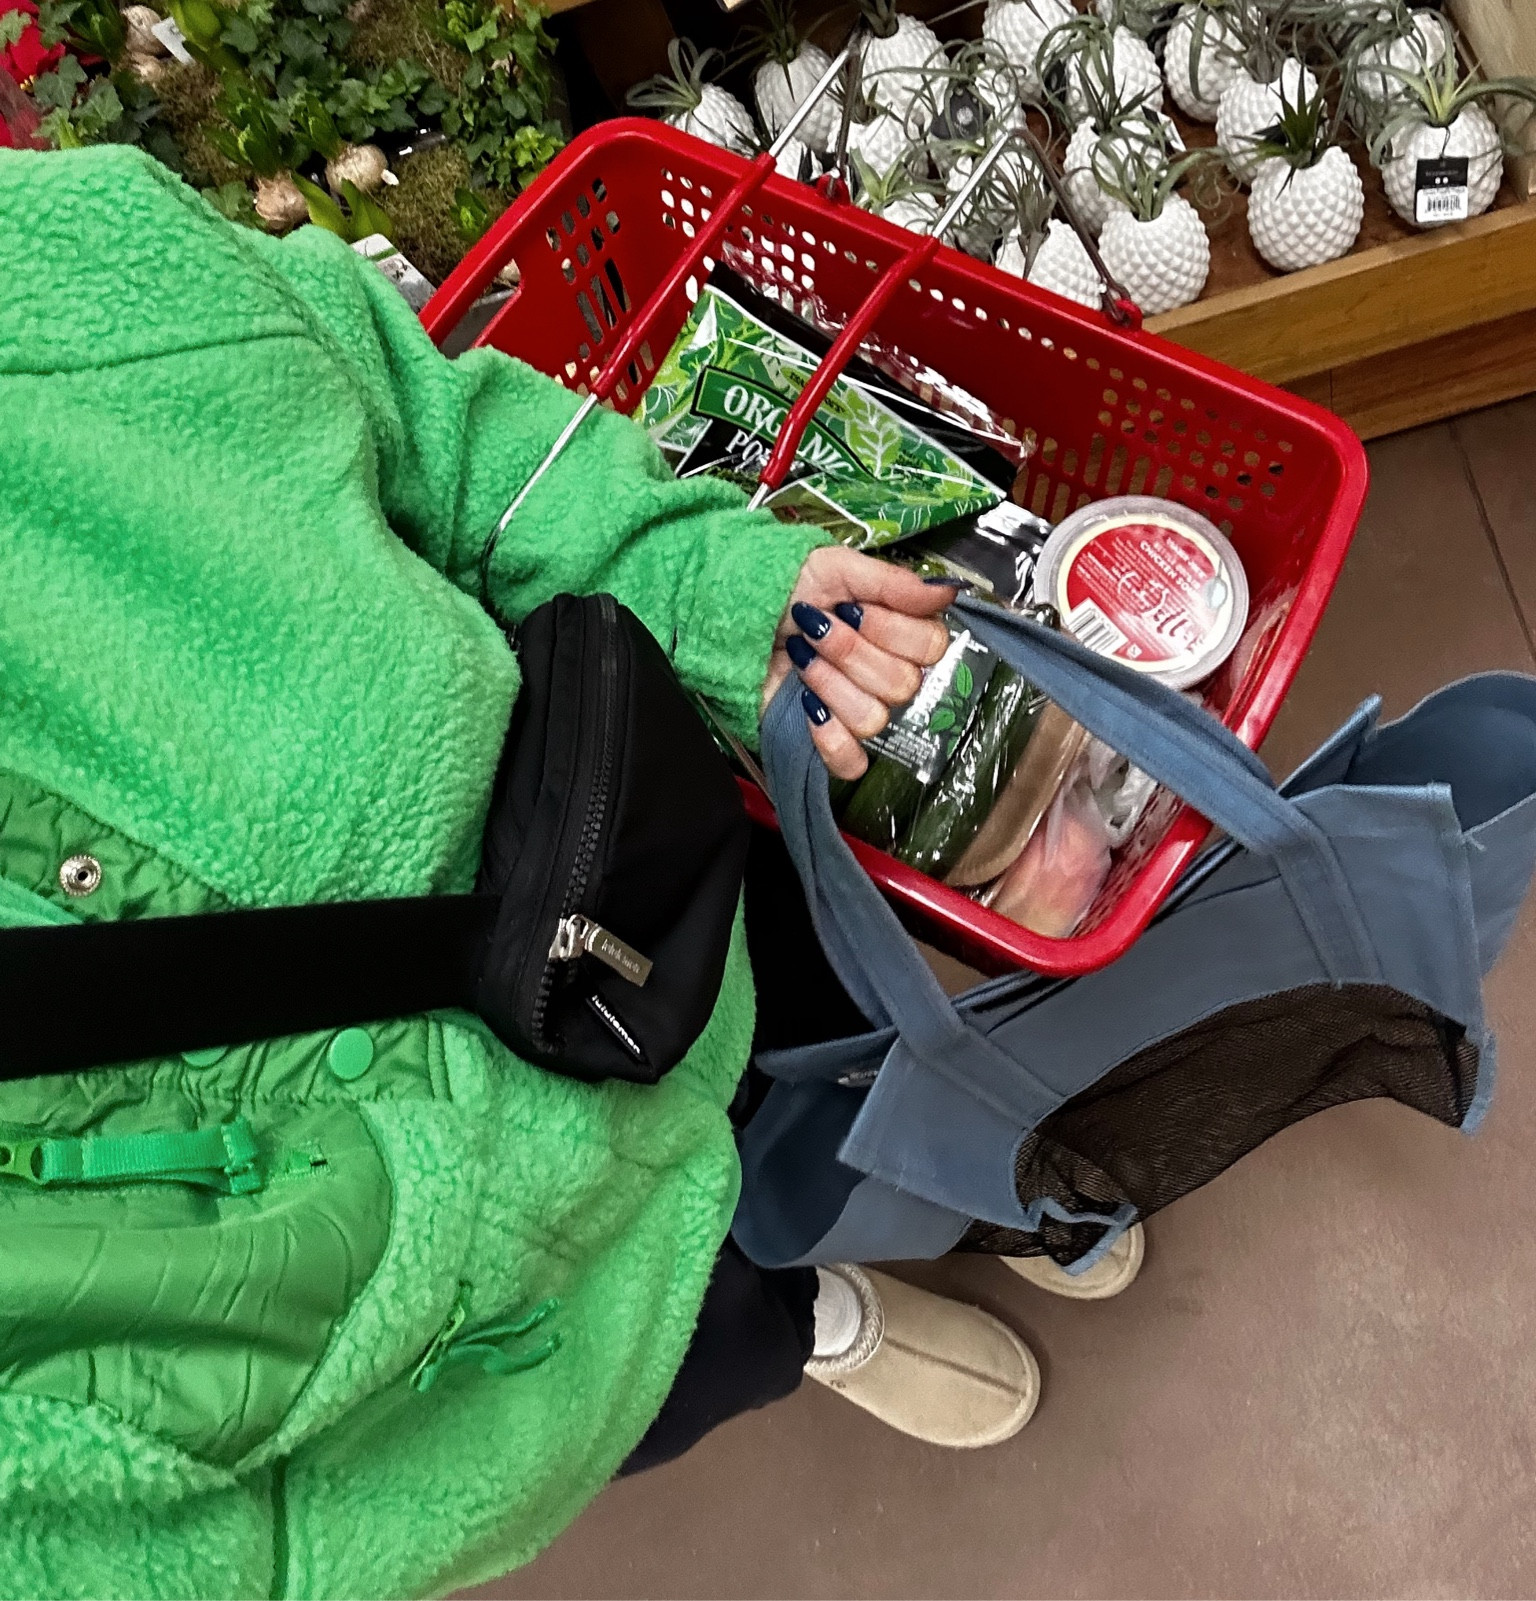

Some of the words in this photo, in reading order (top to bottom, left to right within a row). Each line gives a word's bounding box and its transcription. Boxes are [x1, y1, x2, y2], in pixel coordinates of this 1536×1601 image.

[723, 384, 855, 474] ORGNIC
[1140, 540, 1178, 580] CHICKEN
[591, 994, 640, 1054] lululemon
